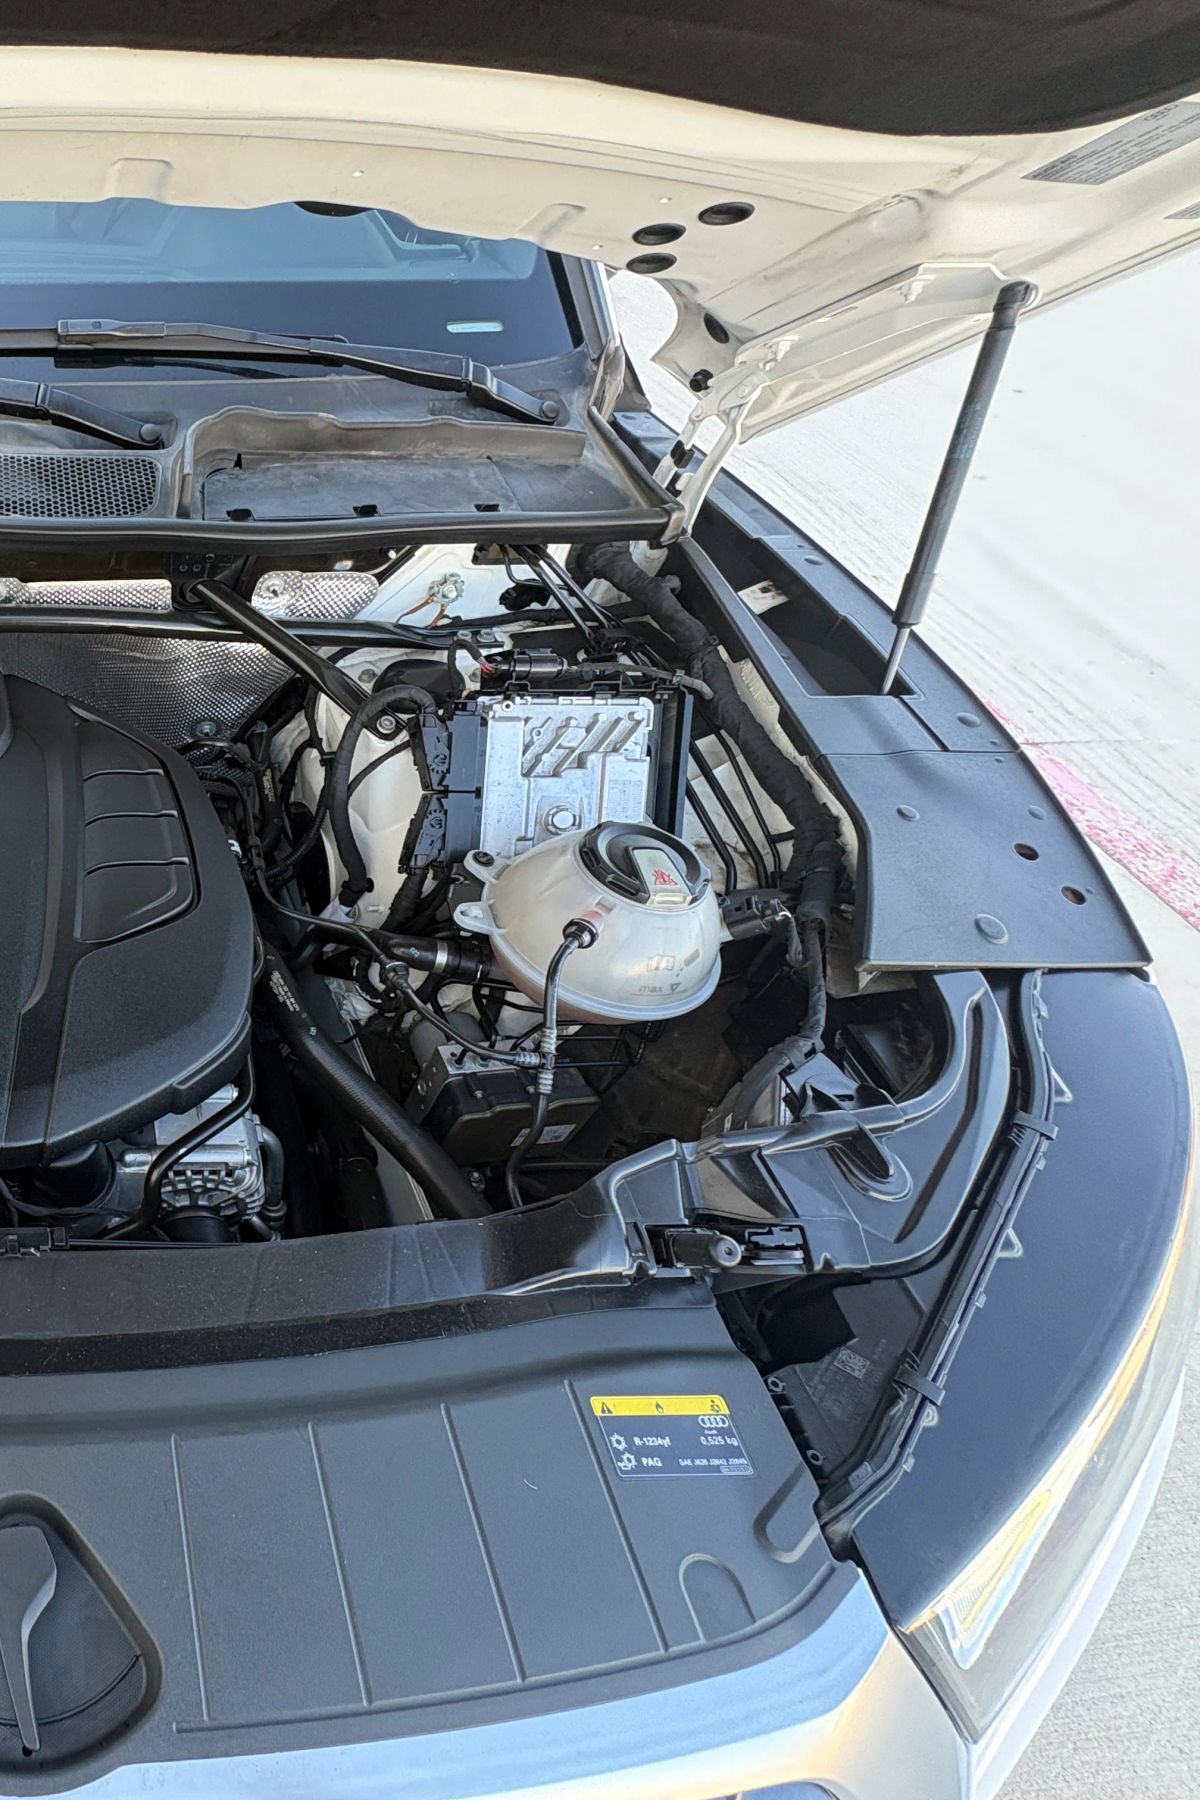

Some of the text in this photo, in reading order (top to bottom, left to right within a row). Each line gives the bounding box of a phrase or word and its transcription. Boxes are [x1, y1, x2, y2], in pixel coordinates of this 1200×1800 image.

[633, 1436, 739, 1448] R-1234yf 0,525 kg
[641, 1457, 663, 1467] PAG
